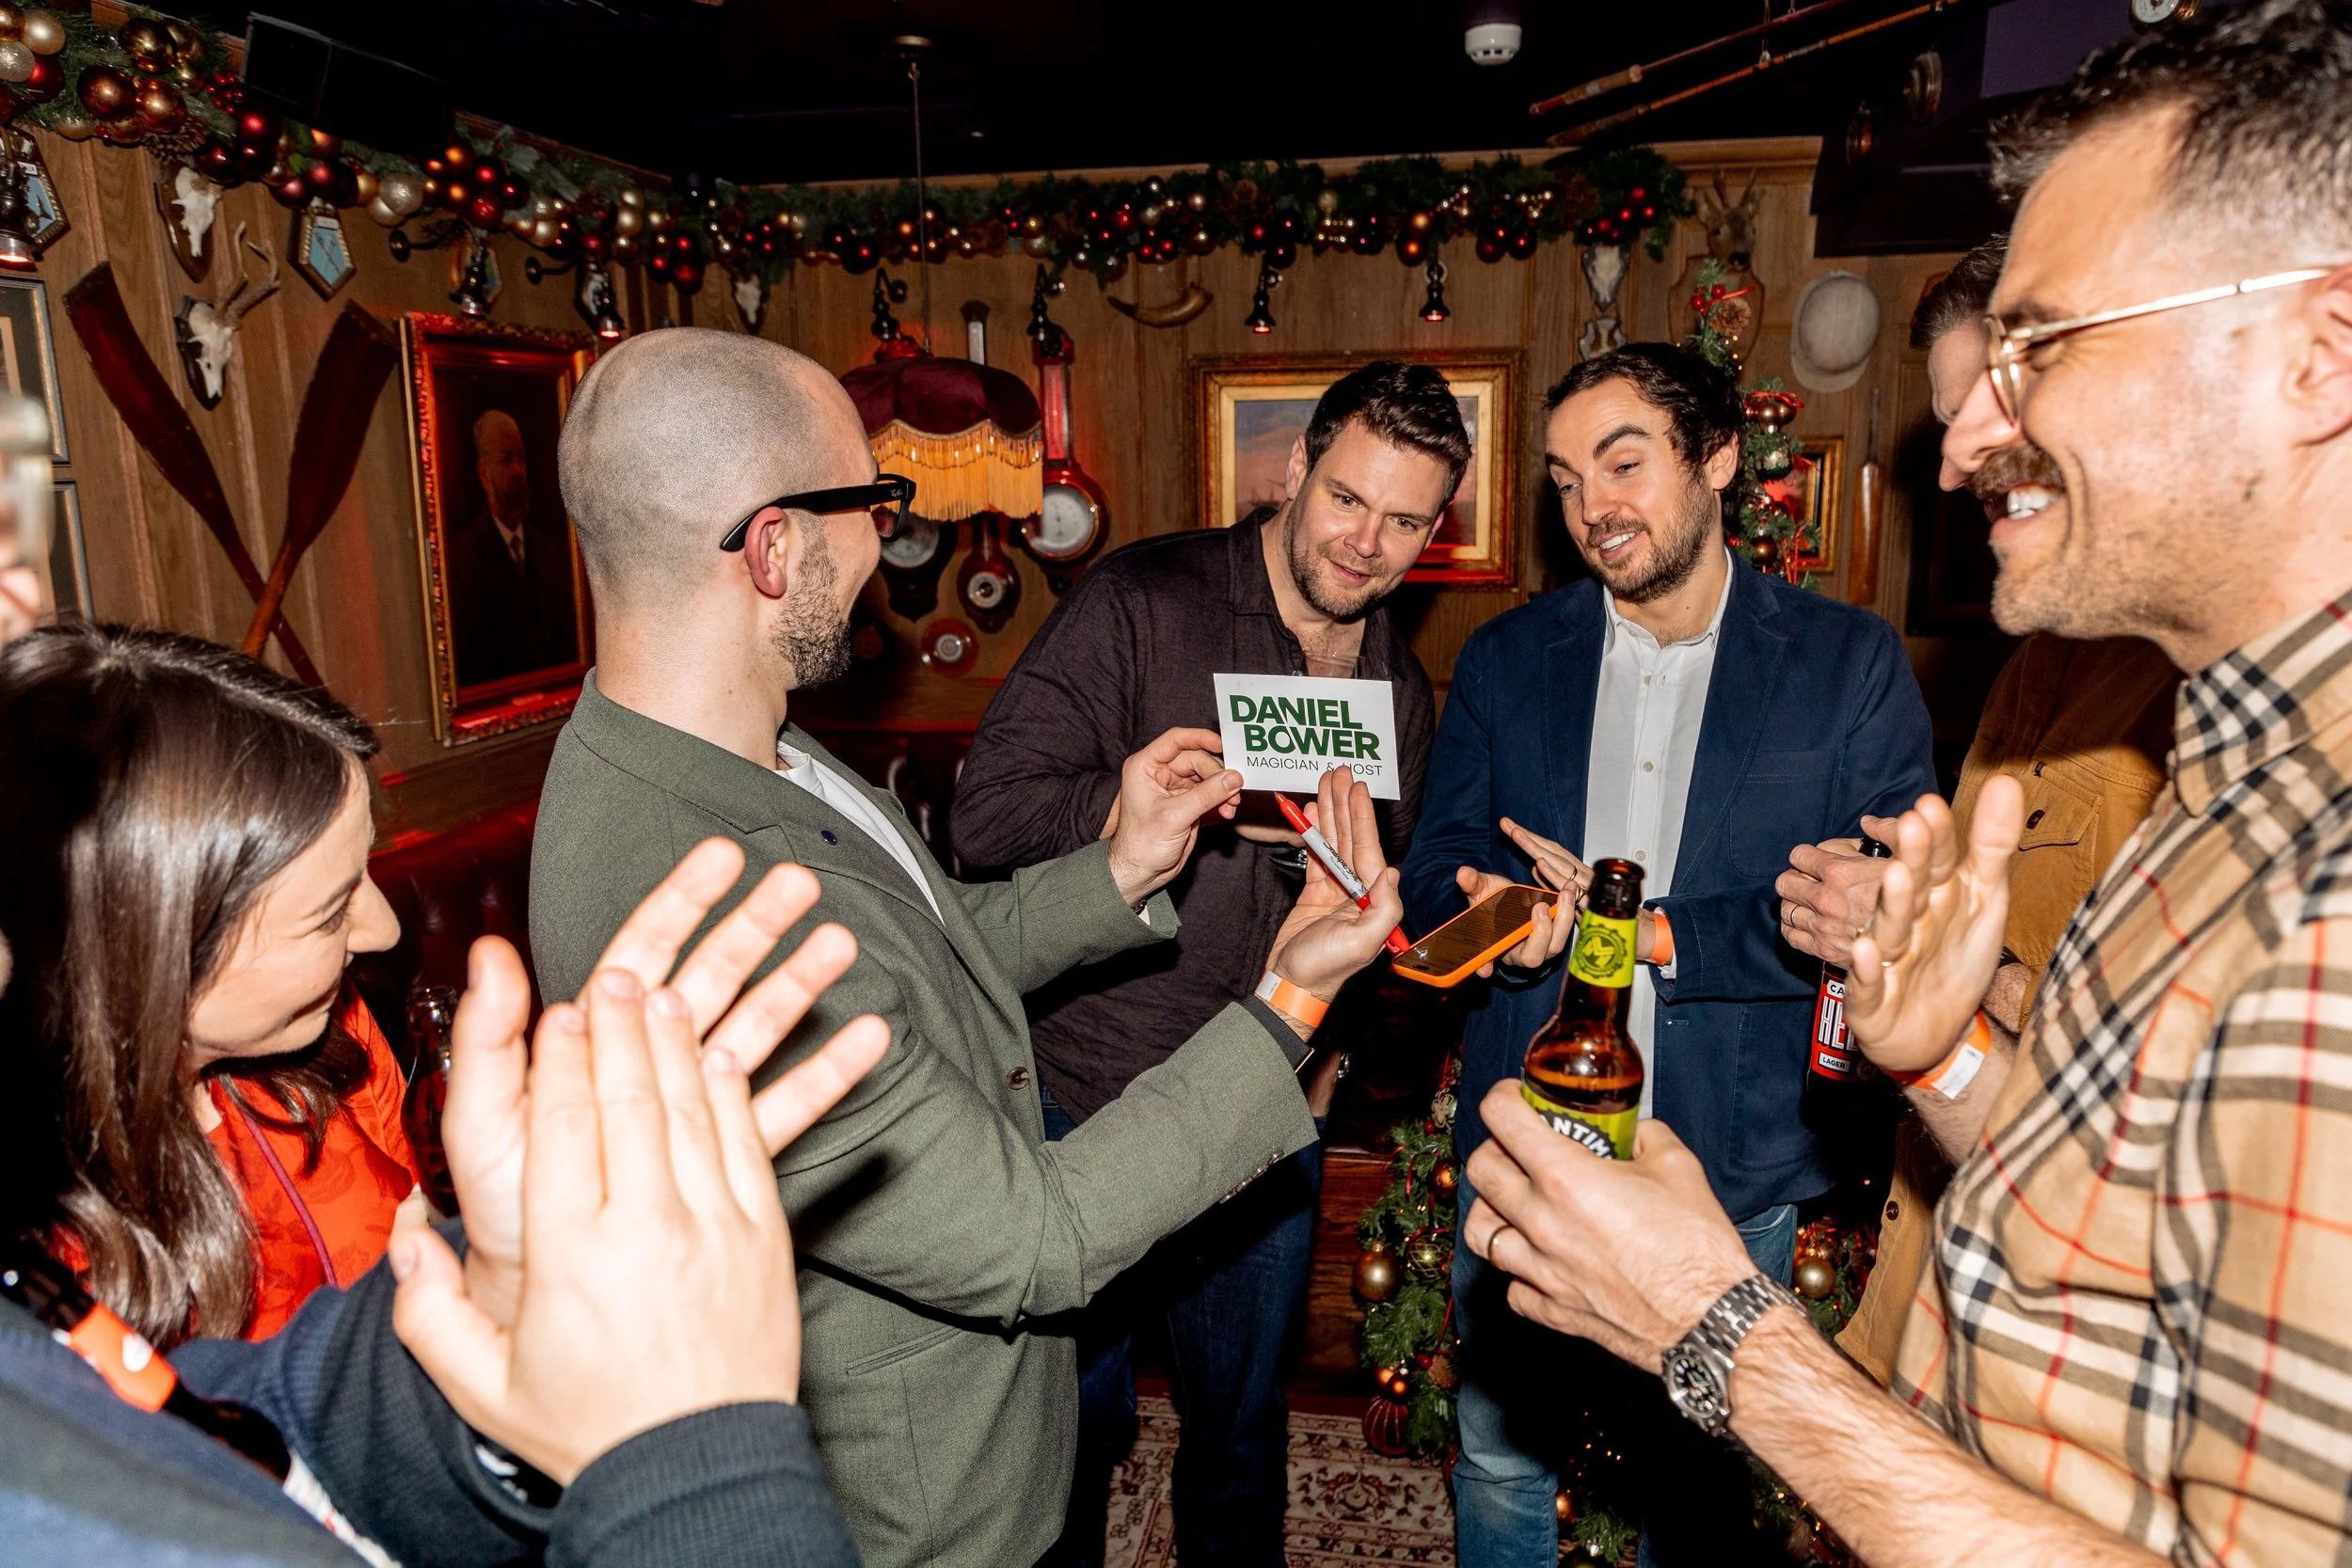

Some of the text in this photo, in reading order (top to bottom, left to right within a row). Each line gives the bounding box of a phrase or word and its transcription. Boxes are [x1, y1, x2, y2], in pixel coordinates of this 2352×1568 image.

[1230, 694, 1362, 729] DANIEL
[1244, 723, 1381, 760] BOWER
[1247, 756, 1319, 770] MAGICIAN
[1327, 762, 1335, 771] &
[1822, 1054, 1846, 1069] LAGER
[1540, 1115, 1613, 1160] NTIM
